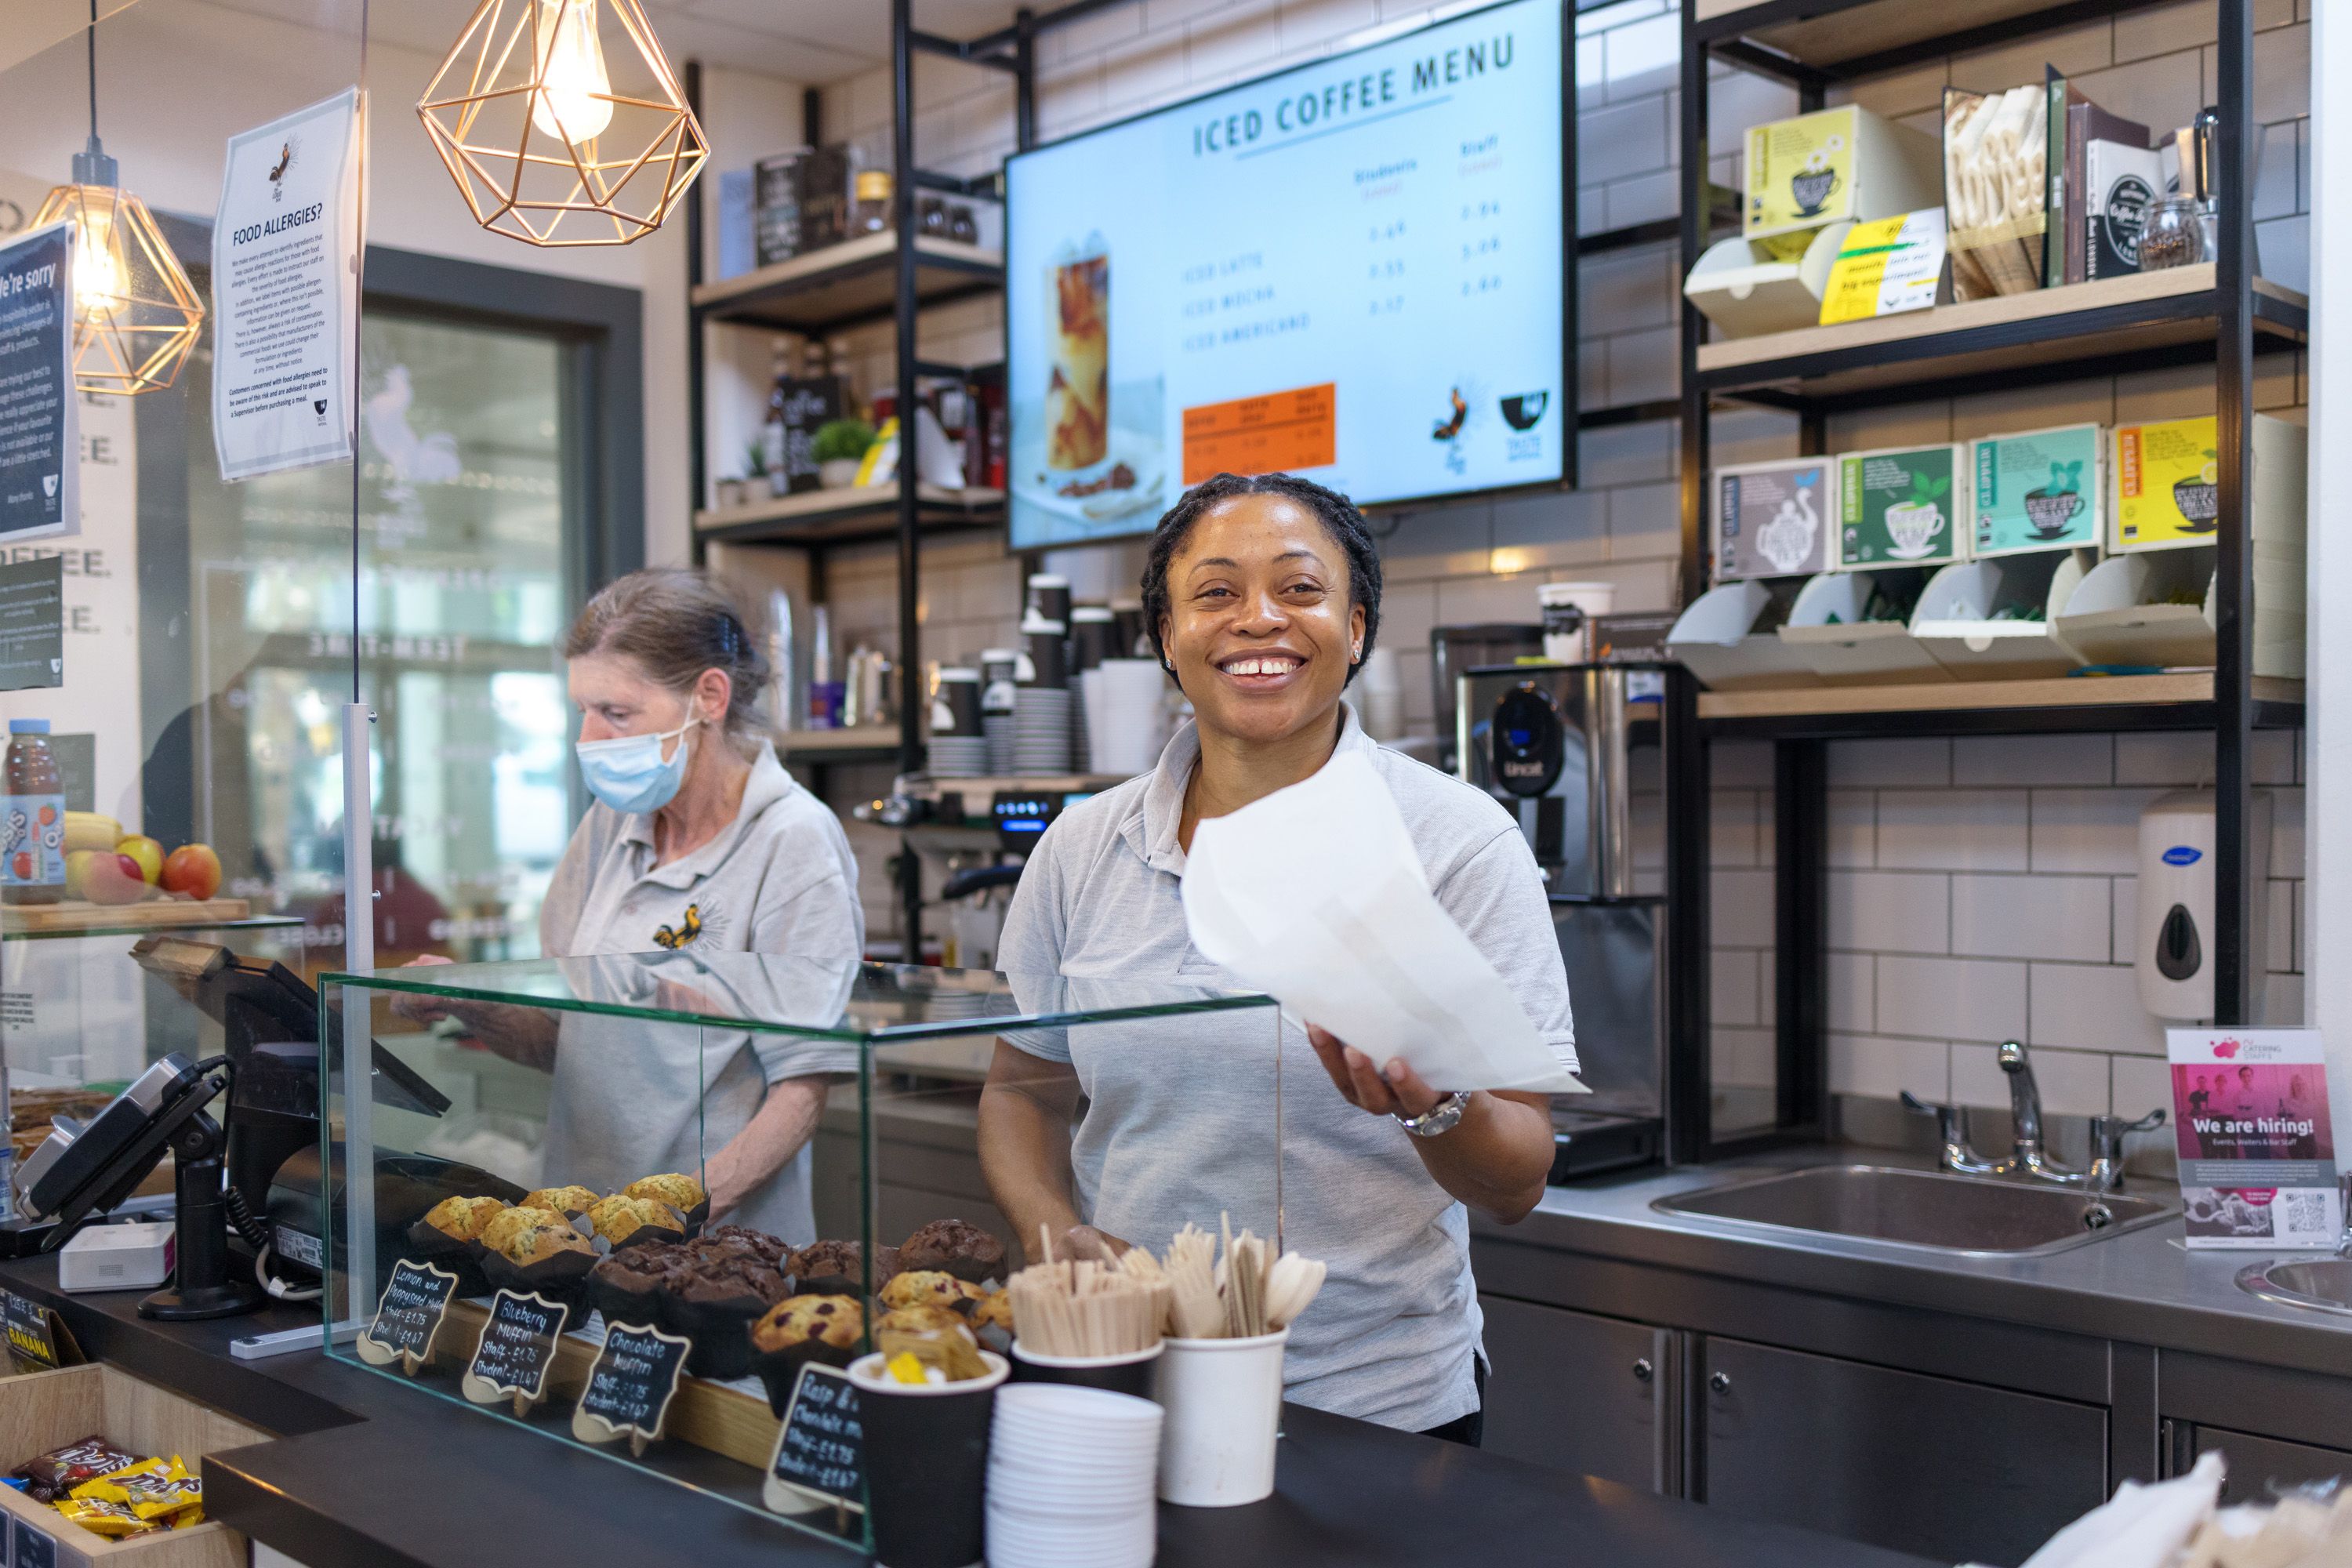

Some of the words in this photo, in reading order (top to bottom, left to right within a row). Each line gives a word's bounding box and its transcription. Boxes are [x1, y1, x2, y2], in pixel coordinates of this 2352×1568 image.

[1194, 109, 1262, 156] ICED
[1276, 69, 1396, 132] COFFEE
[1412, 34, 1513, 94] MENU
[234, 224, 261, 246] FOOD
[264, 202, 322, 237] ALLERGIES?
[253, 261, 267, 270] allergic
[267, 257, 284, 267] reactions
[301, 248, 310, 256] with
[310, 245, 319, 253] food
[259, 248, 274, 258] attempt
[278, 242, 293, 252] identify
[293, 236, 314, 248] ingredients
[25, 263, 56, 289] sorry
[231, 278, 246, 288] allergies.
[257, 271, 268, 280] effort
[272, 267, 282, 275] made
[288, 260, 302, 270] instruct
[309, 256, 318, 264] staff
[259, 281, 273, 290] severity
[278, 276, 286, 285] food
[287, 273, 303, 282] allergies.
[260, 332, 278, 343] possibility
[285, 323, 313, 335] manufacturers
[229, 386, 250, 395] Customers
[250, 379, 271, 390] concerned
[272, 376, 281, 386] with
[282, 374, 292, 383] food
[292, 371, 310, 380] allergies
[310, 367, 322, 376] need
[269, 389, 278, 397] and
[285, 383, 302, 394] advised
[308, 379, 321, 390] speak
[234, 406, 254, 417] Supervisor
[268, 397, 291, 410] purchasing
[295, 393, 307, 402] meal.
[2193, 1118, 2220, 1134] We
[2225, 1121, 2254, 1133] are
[2257, 1117, 2314, 1137] hiring!
[397, 1268, 423, 1287] Lemon
[425, 1280, 441, 1290] and
[501, 1301, 546, 1336] Blueberry
[8, 1327, 50, 1360] BANANA
[497, 1323, 532, 1342] Muffin
[483, 1341, 506, 1360] Staff
[610, 1332, 666, 1358] Chocolate
[593, 1373, 618, 1394] Staff
